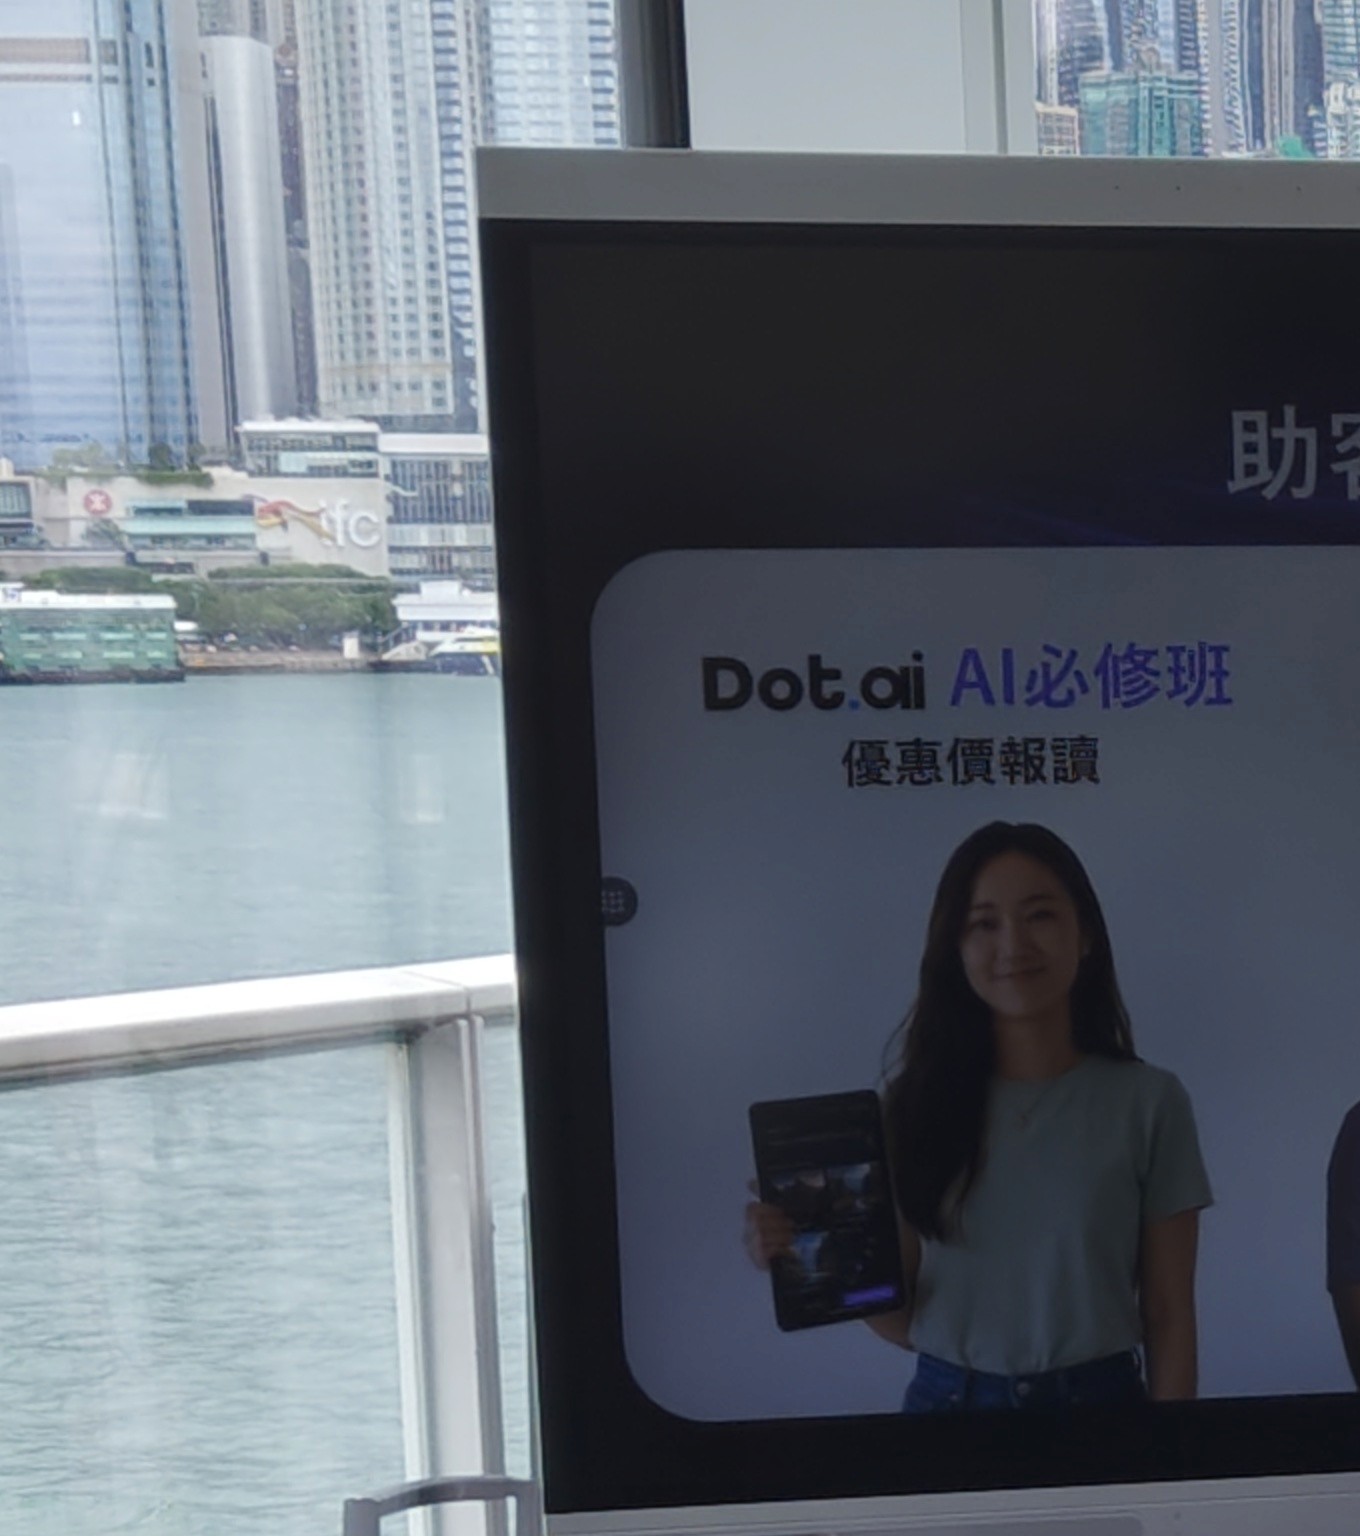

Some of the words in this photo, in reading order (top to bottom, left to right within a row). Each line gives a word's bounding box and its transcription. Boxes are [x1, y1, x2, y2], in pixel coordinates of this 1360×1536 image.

[702, 650, 926, 712] Dot.ai
[950, 641, 1234, 710] AI必修班
[842, 735, 1101, 789] 優惠價報讀
